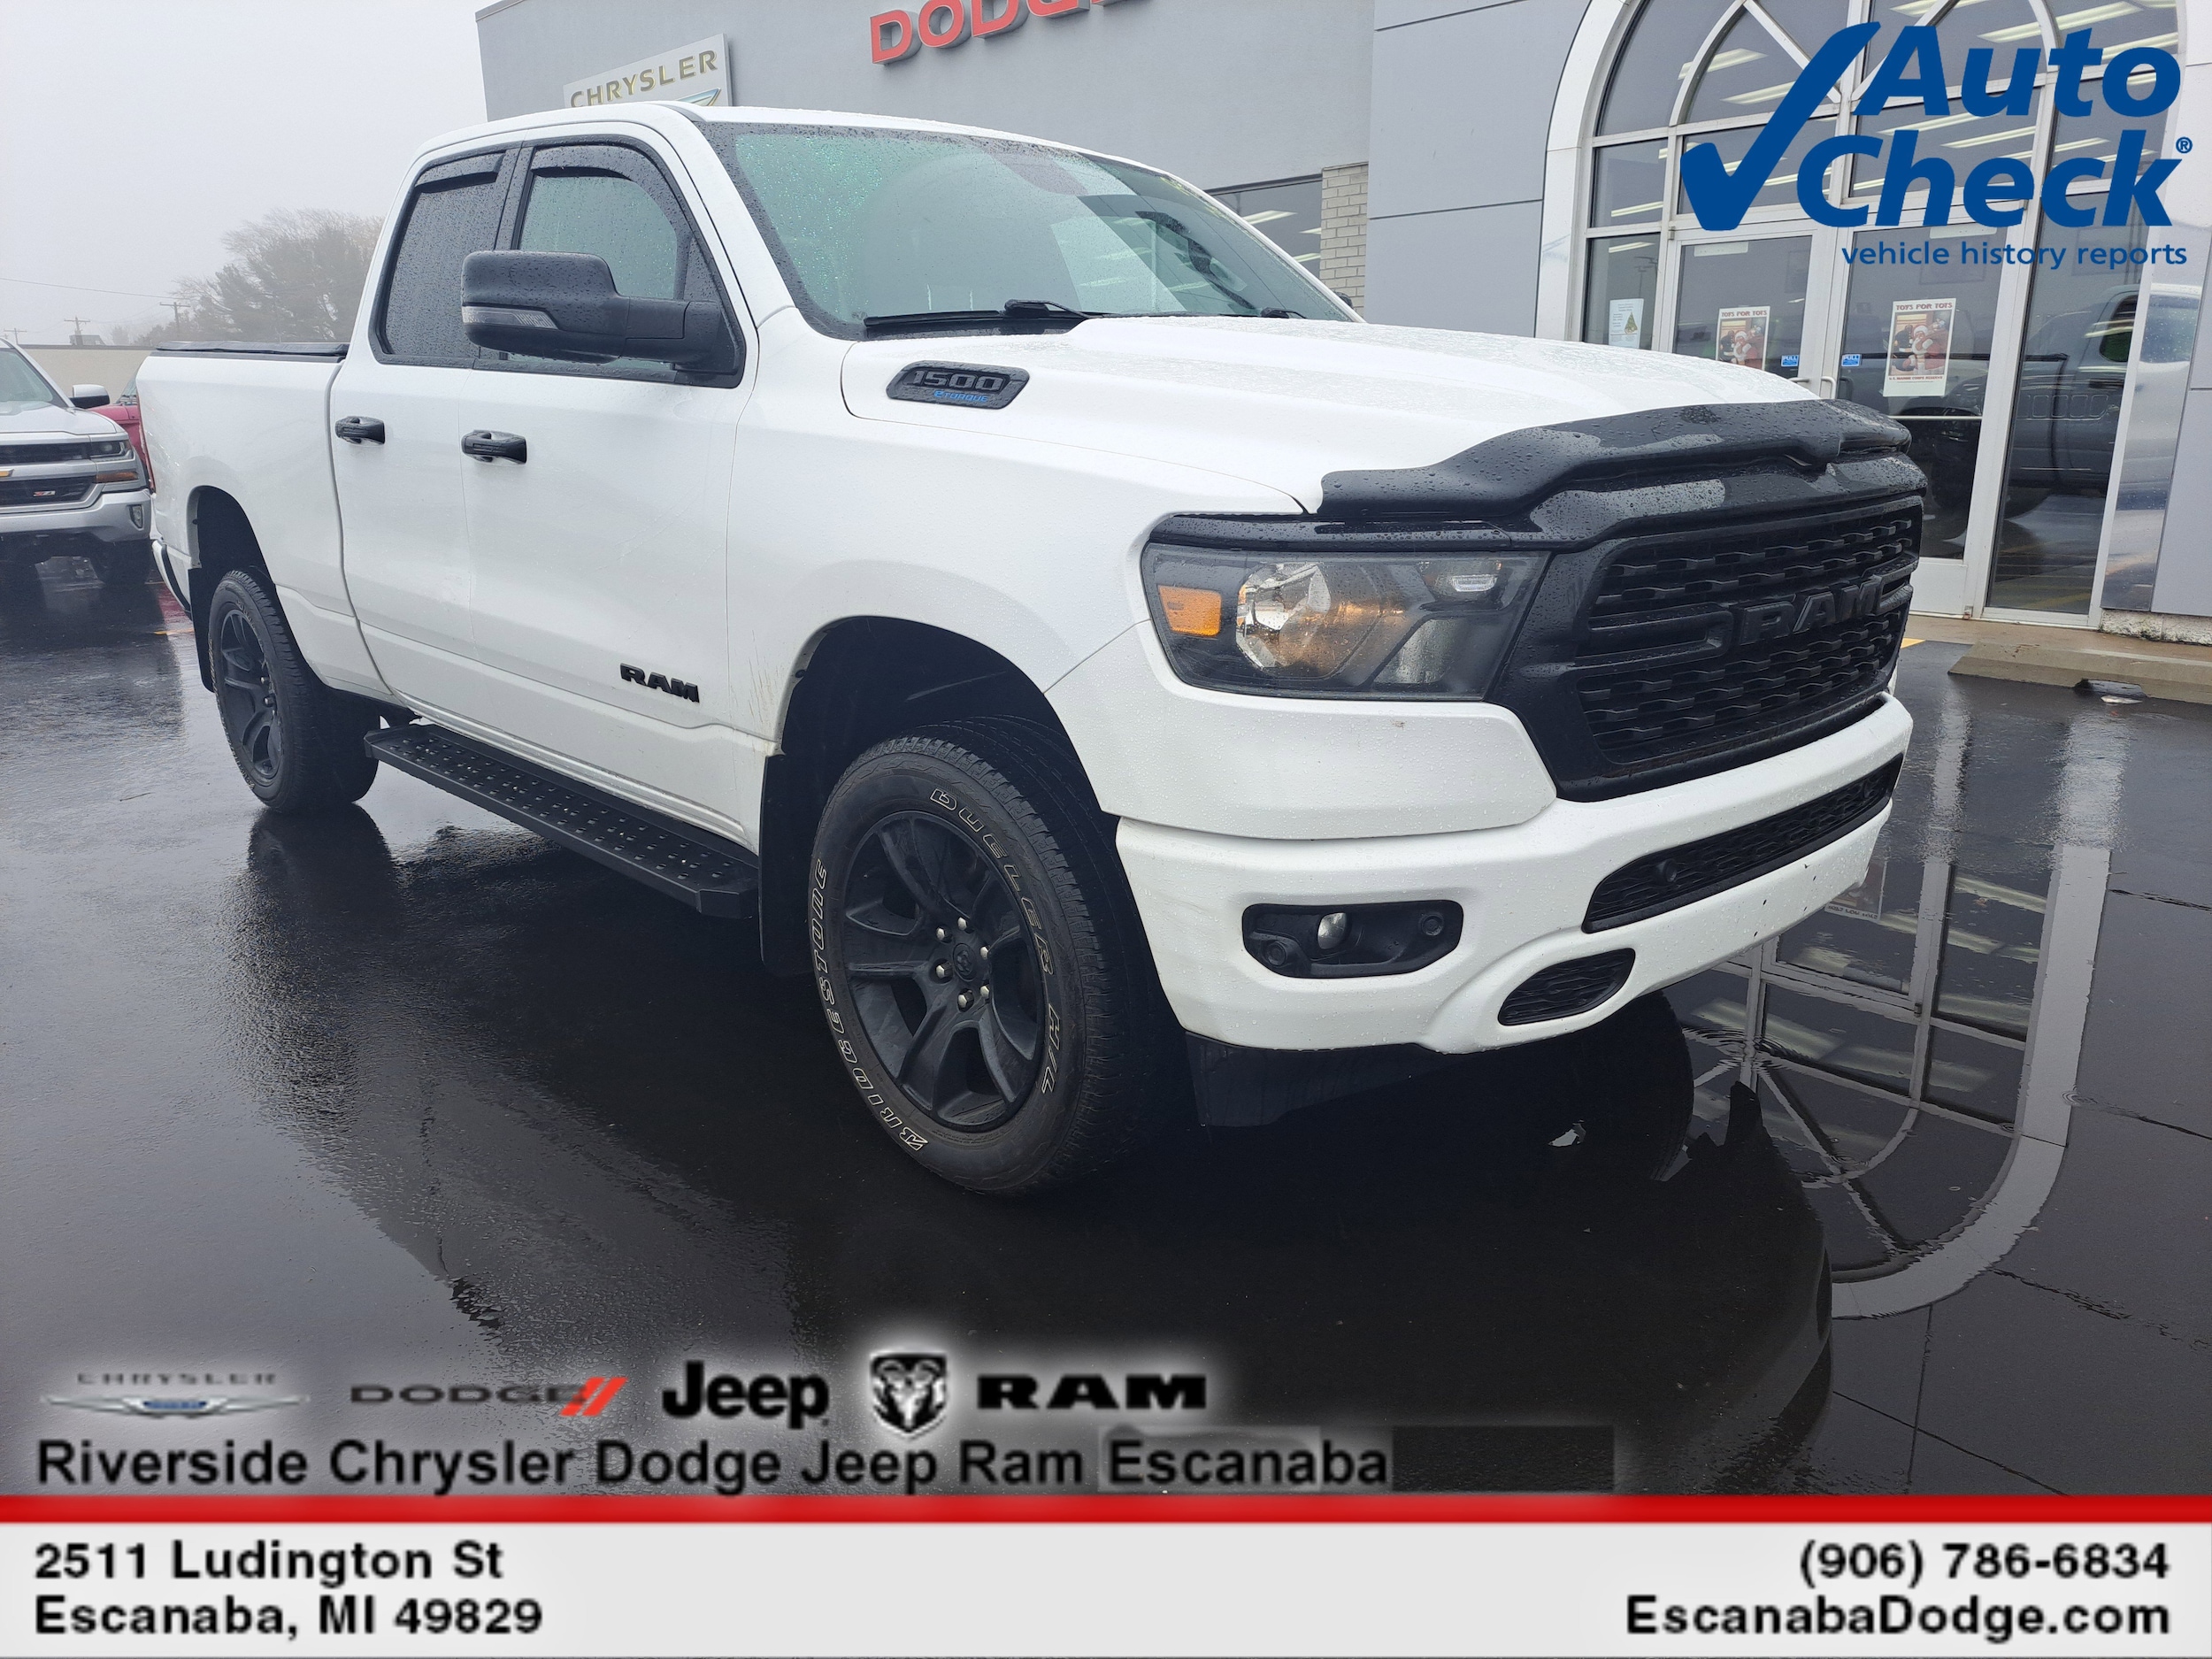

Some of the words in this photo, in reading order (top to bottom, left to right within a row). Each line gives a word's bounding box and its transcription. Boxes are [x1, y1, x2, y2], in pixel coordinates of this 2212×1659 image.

[870, 0, 1128, 64] DOD
[570, 50, 718, 107] CHRYSLER
[910, 370, 1006, 392] 1500
[1739, 579, 1883, 647] RAM
[620, 663, 700, 703] RAM
[930, 787, 1054, 976] DUELER
[810, 858, 929, 1152] BRIDGESTONE
